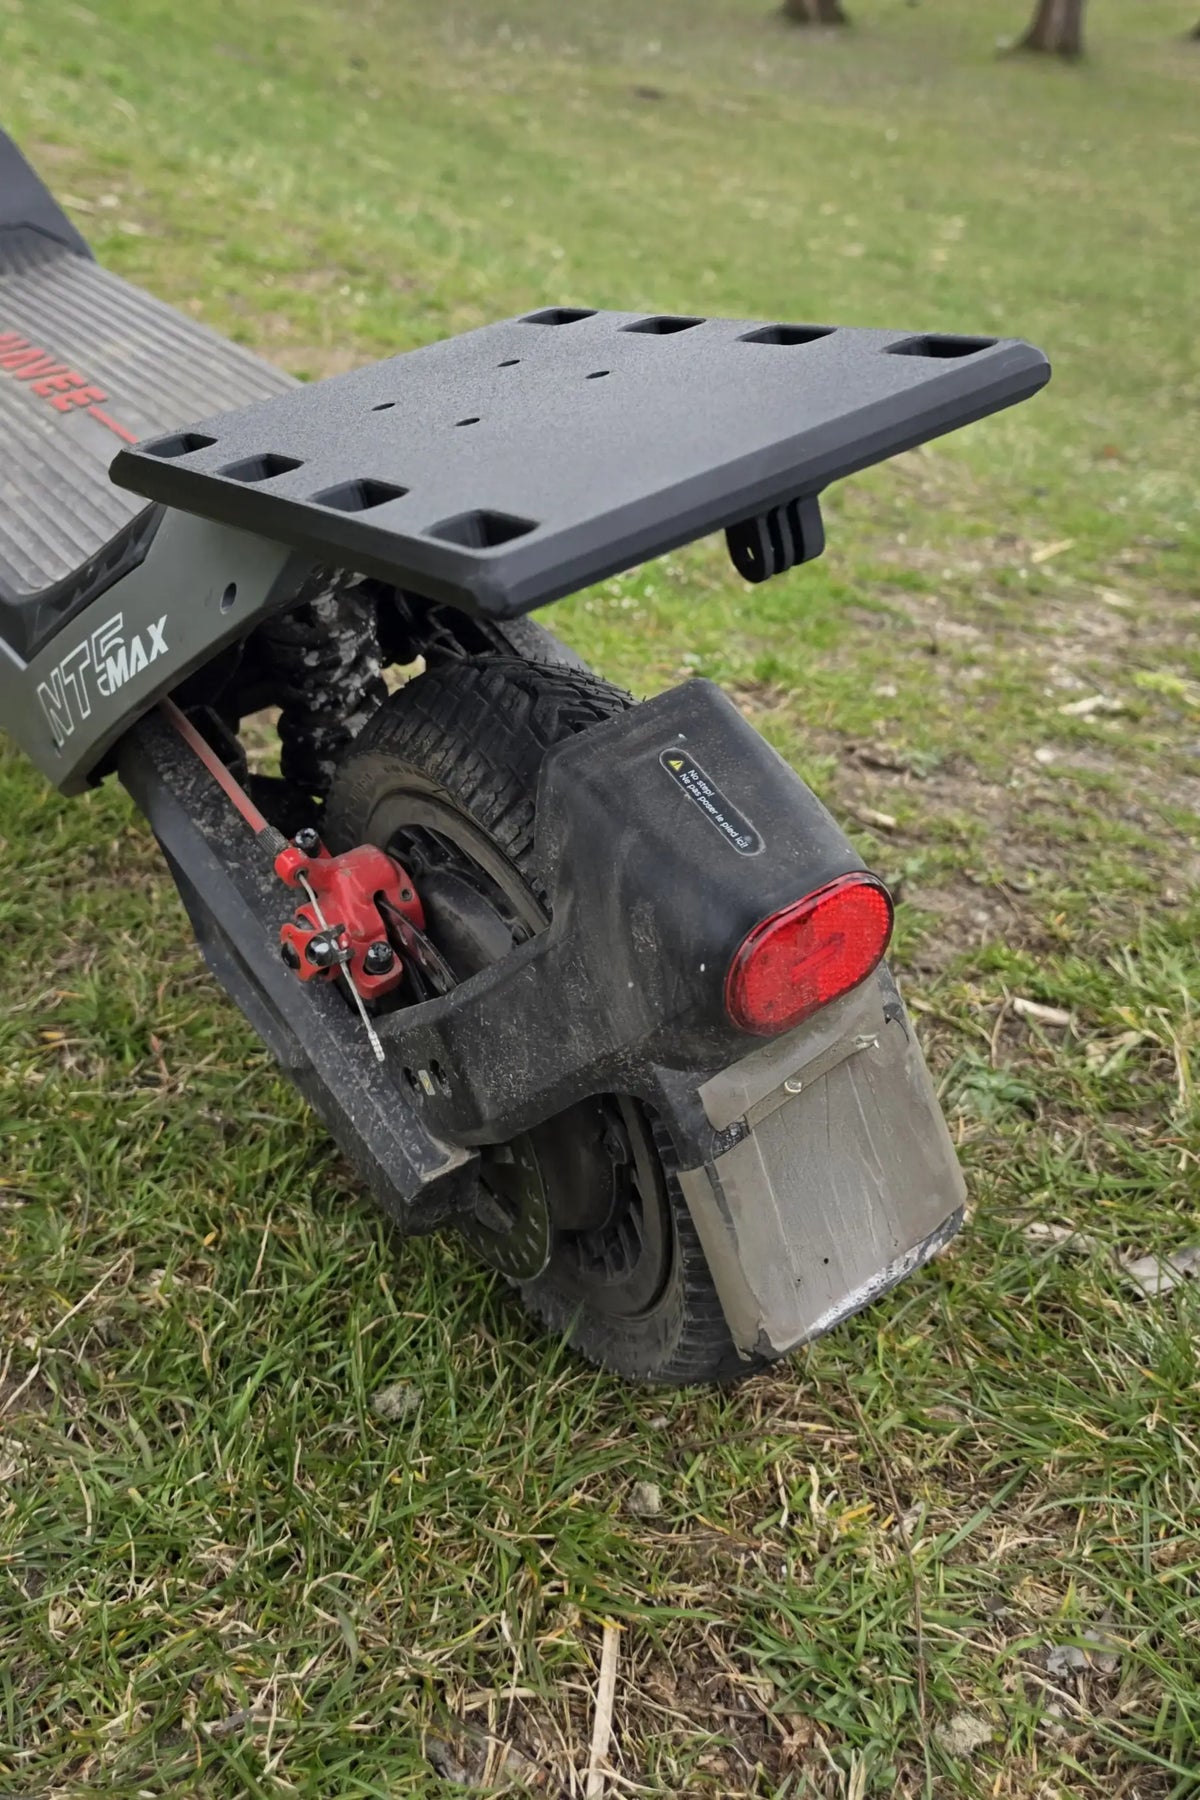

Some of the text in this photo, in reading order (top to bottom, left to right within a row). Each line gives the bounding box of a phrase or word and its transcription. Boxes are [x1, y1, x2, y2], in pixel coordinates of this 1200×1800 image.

[105, 614, 169, 694] MAX
[679, 773, 749, 849] Ne pas poser le pied ici!
[688, 769, 715, 797] No step!
